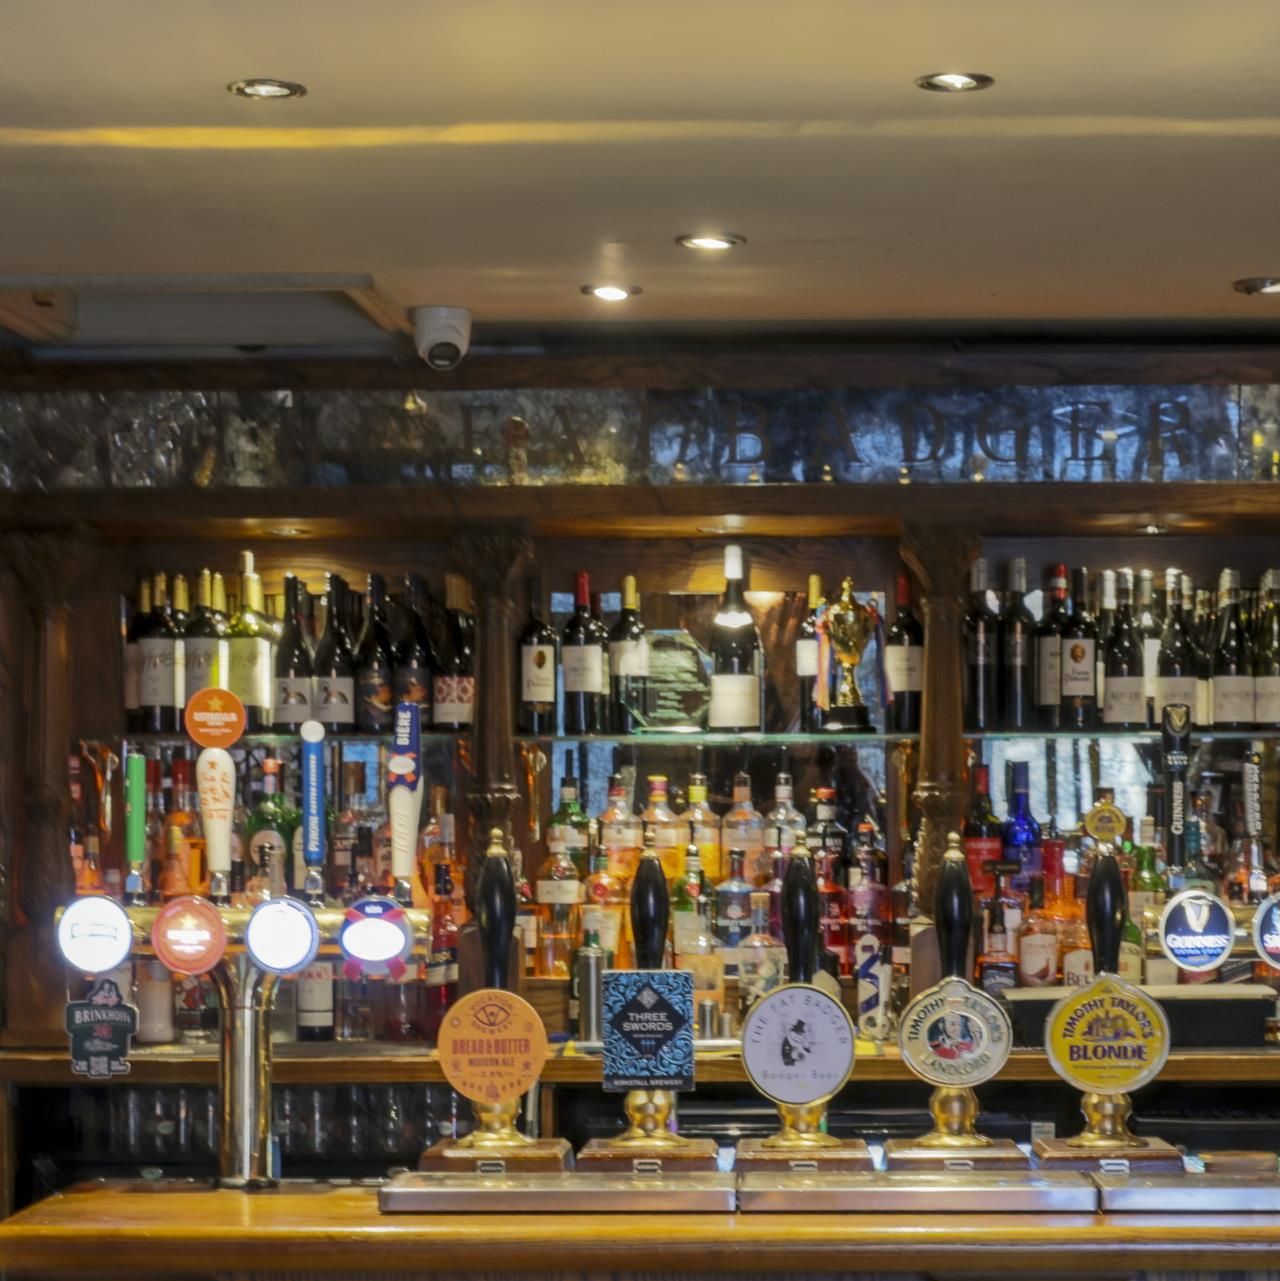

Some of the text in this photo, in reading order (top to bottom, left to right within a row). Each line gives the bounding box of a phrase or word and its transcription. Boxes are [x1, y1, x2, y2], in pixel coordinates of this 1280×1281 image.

[1171, 781, 1184, 835] GUINNESS
[1167, 934, 1230, 949] GUINNESS
[623, 1022, 673, 1031] SWORDS
[627, 1012, 668, 1021] THREE
[770, 993, 798, 1012] FAT
[804, 994, 849, 1044] BADGER
[908, 996, 946, 1041] TIMOTHY
[1062, 996, 1154, 1039] TIMOTHY TAYLOR'S
[452, 1039, 484, 1055] BREAD
[494, 1039, 531, 1055] BUTTER
[1069, 1044, 1149, 1062] BLONDE
[922, 1051, 991, 1075] LANDLORD
